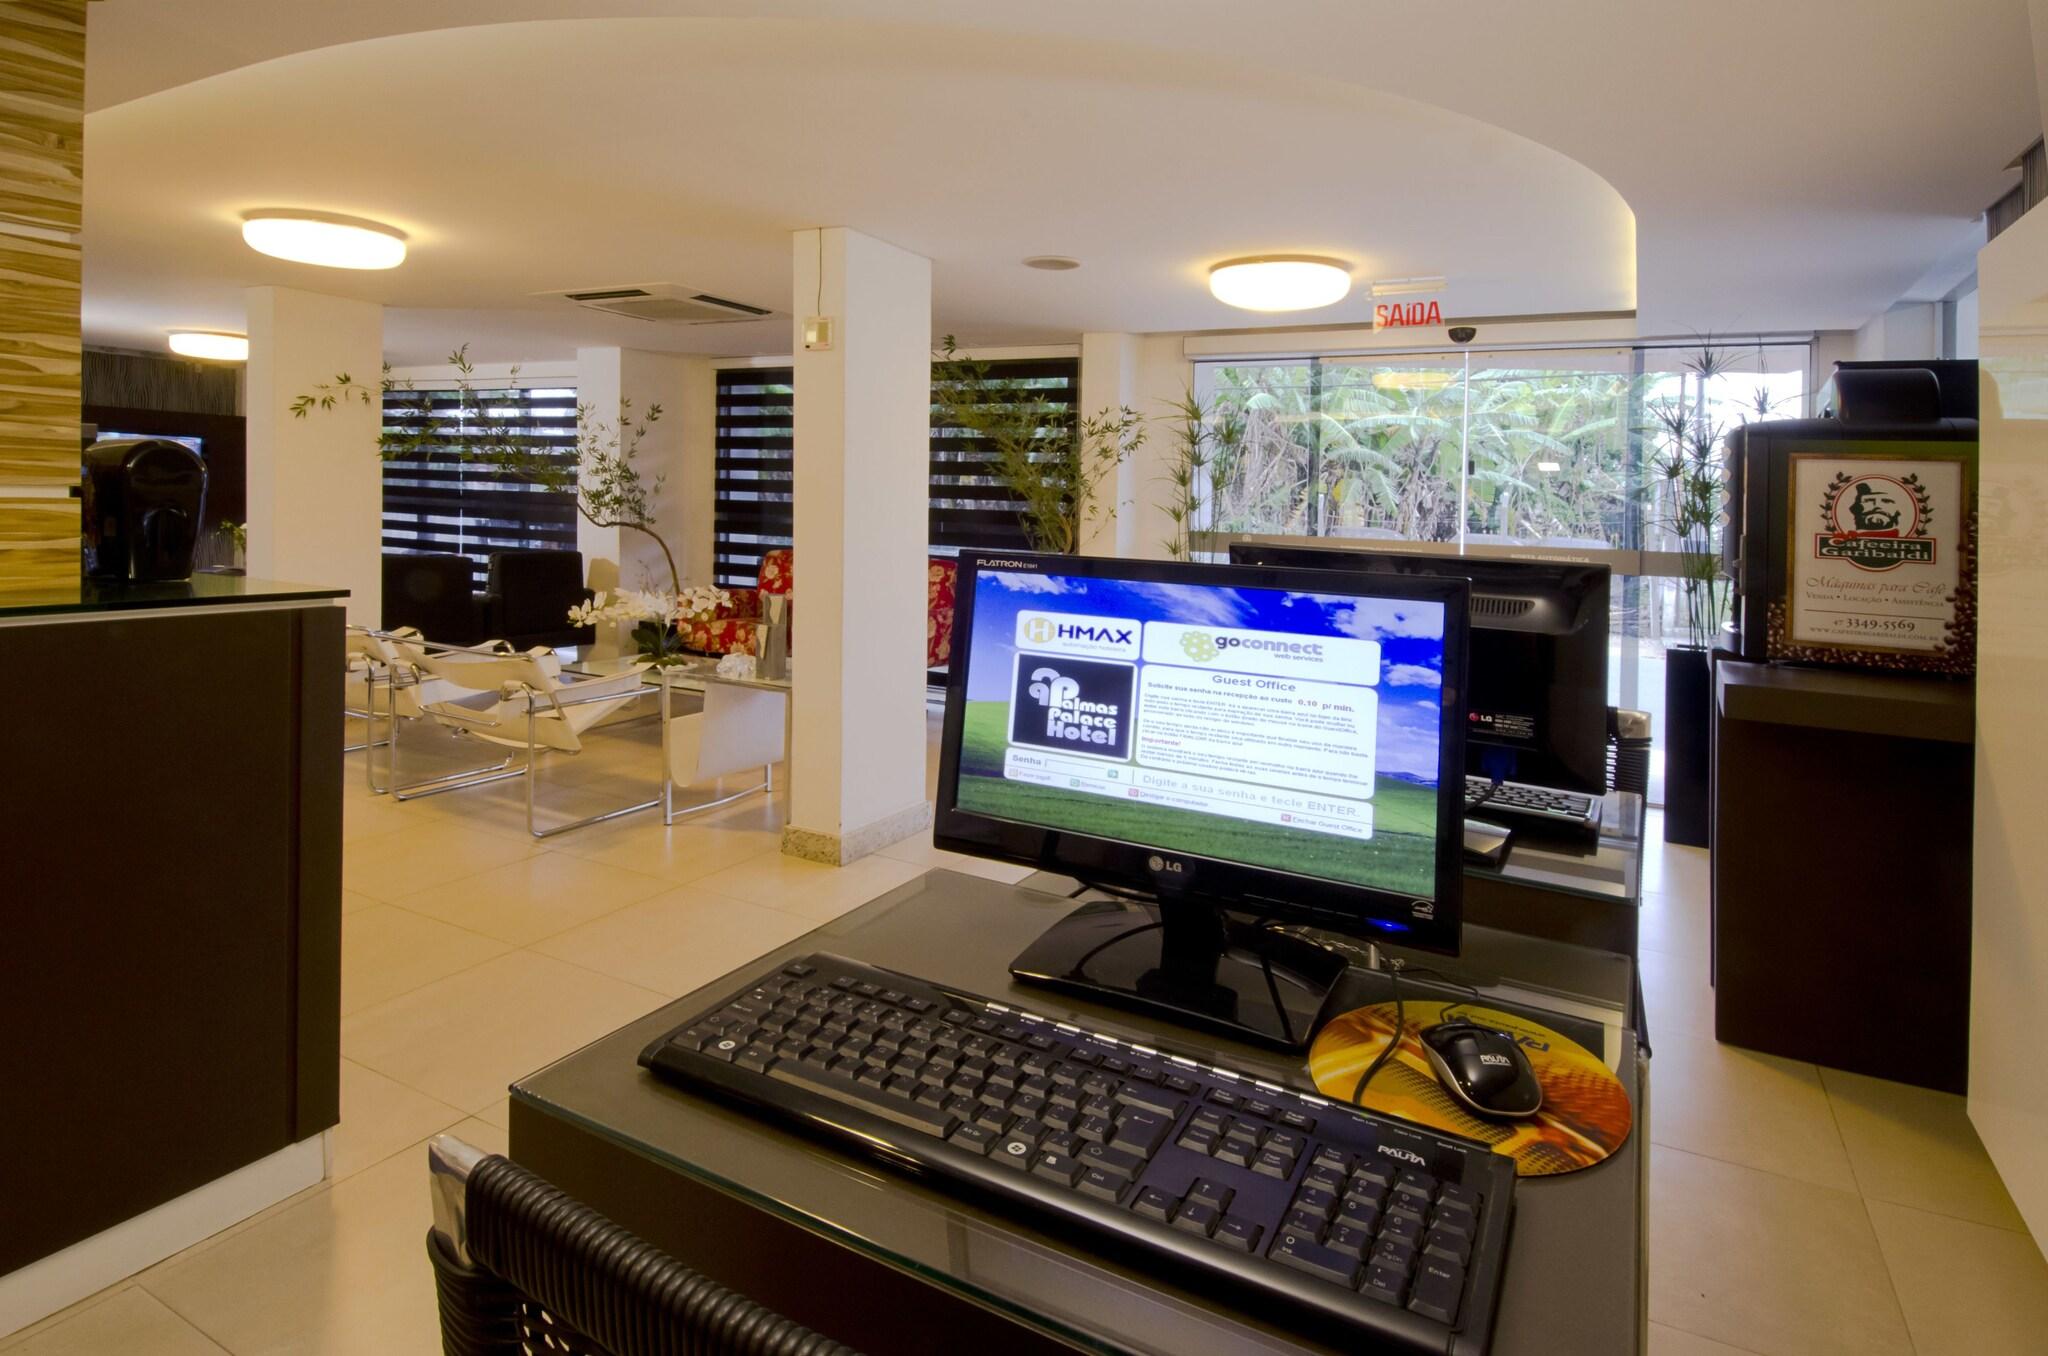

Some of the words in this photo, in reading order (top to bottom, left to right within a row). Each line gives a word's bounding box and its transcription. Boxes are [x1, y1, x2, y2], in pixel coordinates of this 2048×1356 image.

[1375, 300, 1441, 327] SAÍDA
[1828, 537, 1922, 551] Cafeeira
[1821, 547, 1930, 560] Garibaldi
[976, 559, 1023, 569] FLATRON
[1877, 582, 1908, 594] para
[1057, 623, 1133, 645] HMAX
[1292, 654, 1324, 663] services
[1189, 685, 1212, 695] senha
[1212, 675, 1252, 688] Guest
[1255, 679, 1297, 692] Office
[1048, 676, 1118, 716] Palmas
[1047, 707, 1117, 729] Palace
[1480, 714, 1493, 723] LG
[1046, 718, 1117, 746] Hotel
[1012, 754, 1041, 766] Senha
[1143, 775, 1178, 787] Digite
[1191, 784, 1214, 794] sua
[1218, 787, 1257, 801] senha
[1165, 860, 1183, 873] LG
